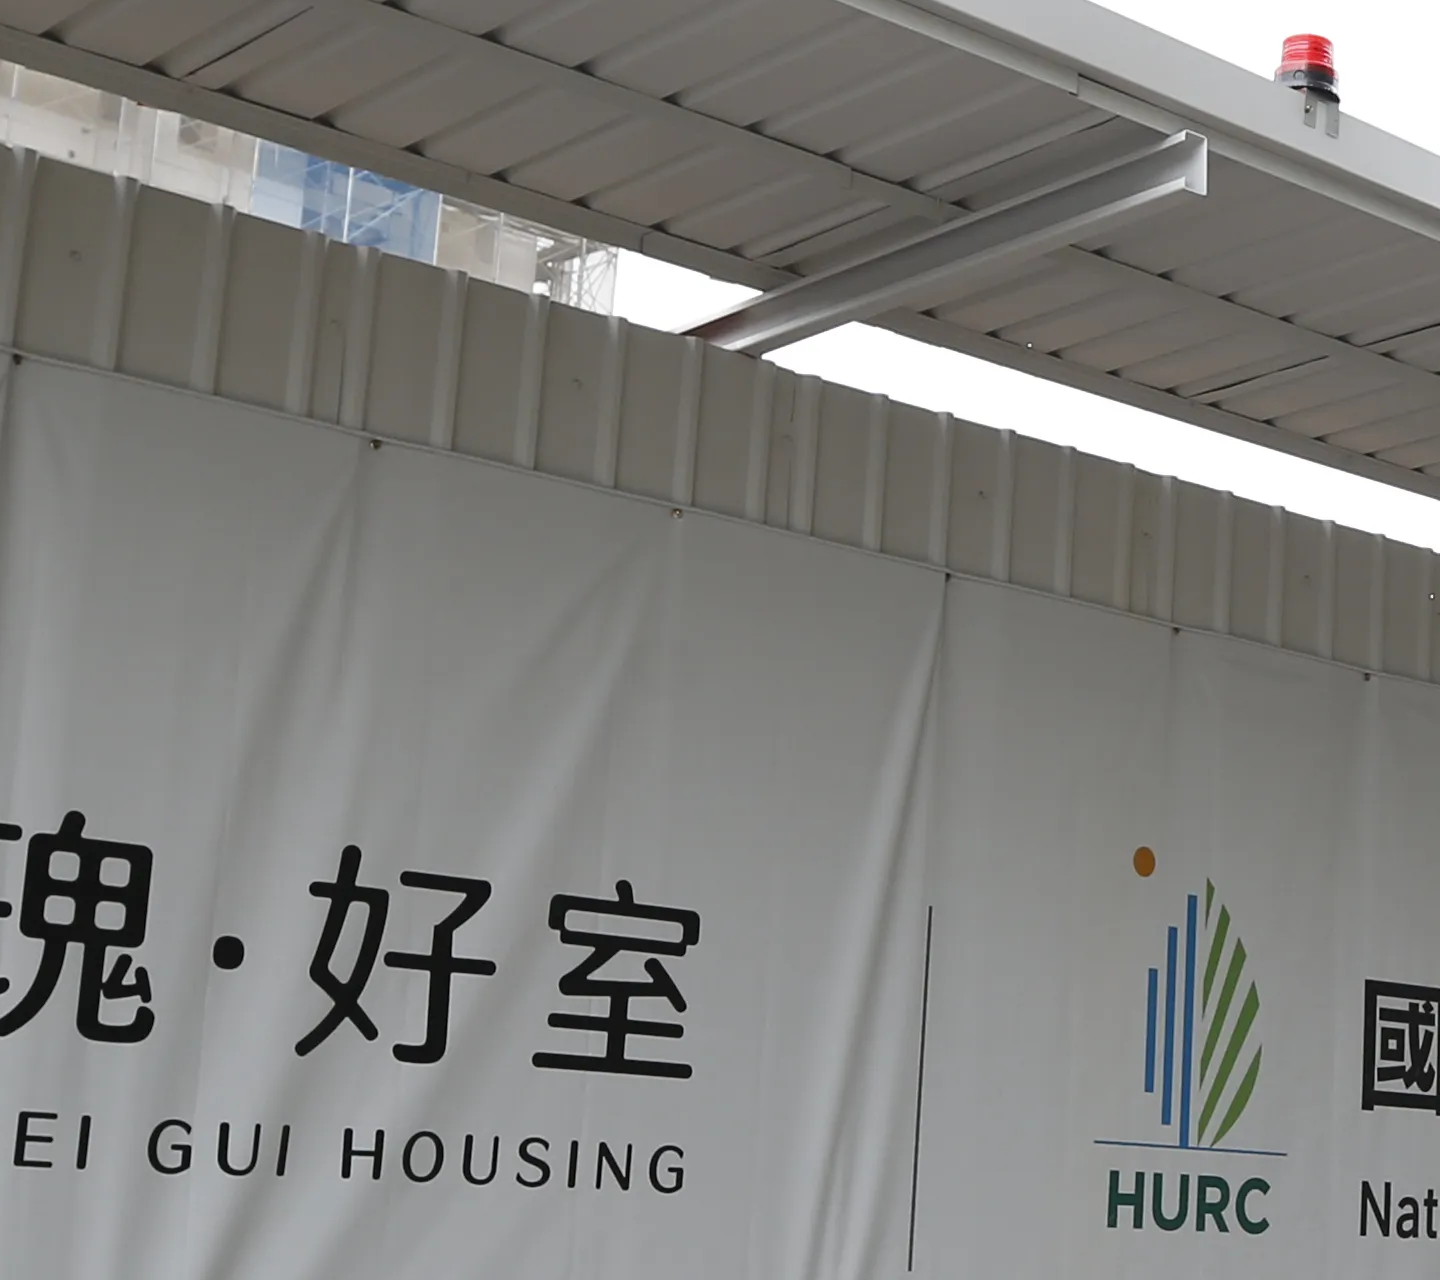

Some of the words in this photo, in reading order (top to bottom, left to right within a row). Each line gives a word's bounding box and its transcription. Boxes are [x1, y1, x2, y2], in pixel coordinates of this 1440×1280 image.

[147, 1118, 291, 1177] GUI
[341, 1127, 686, 1194] HOUSING
[1106, 1169, 1271, 1235] HURC
